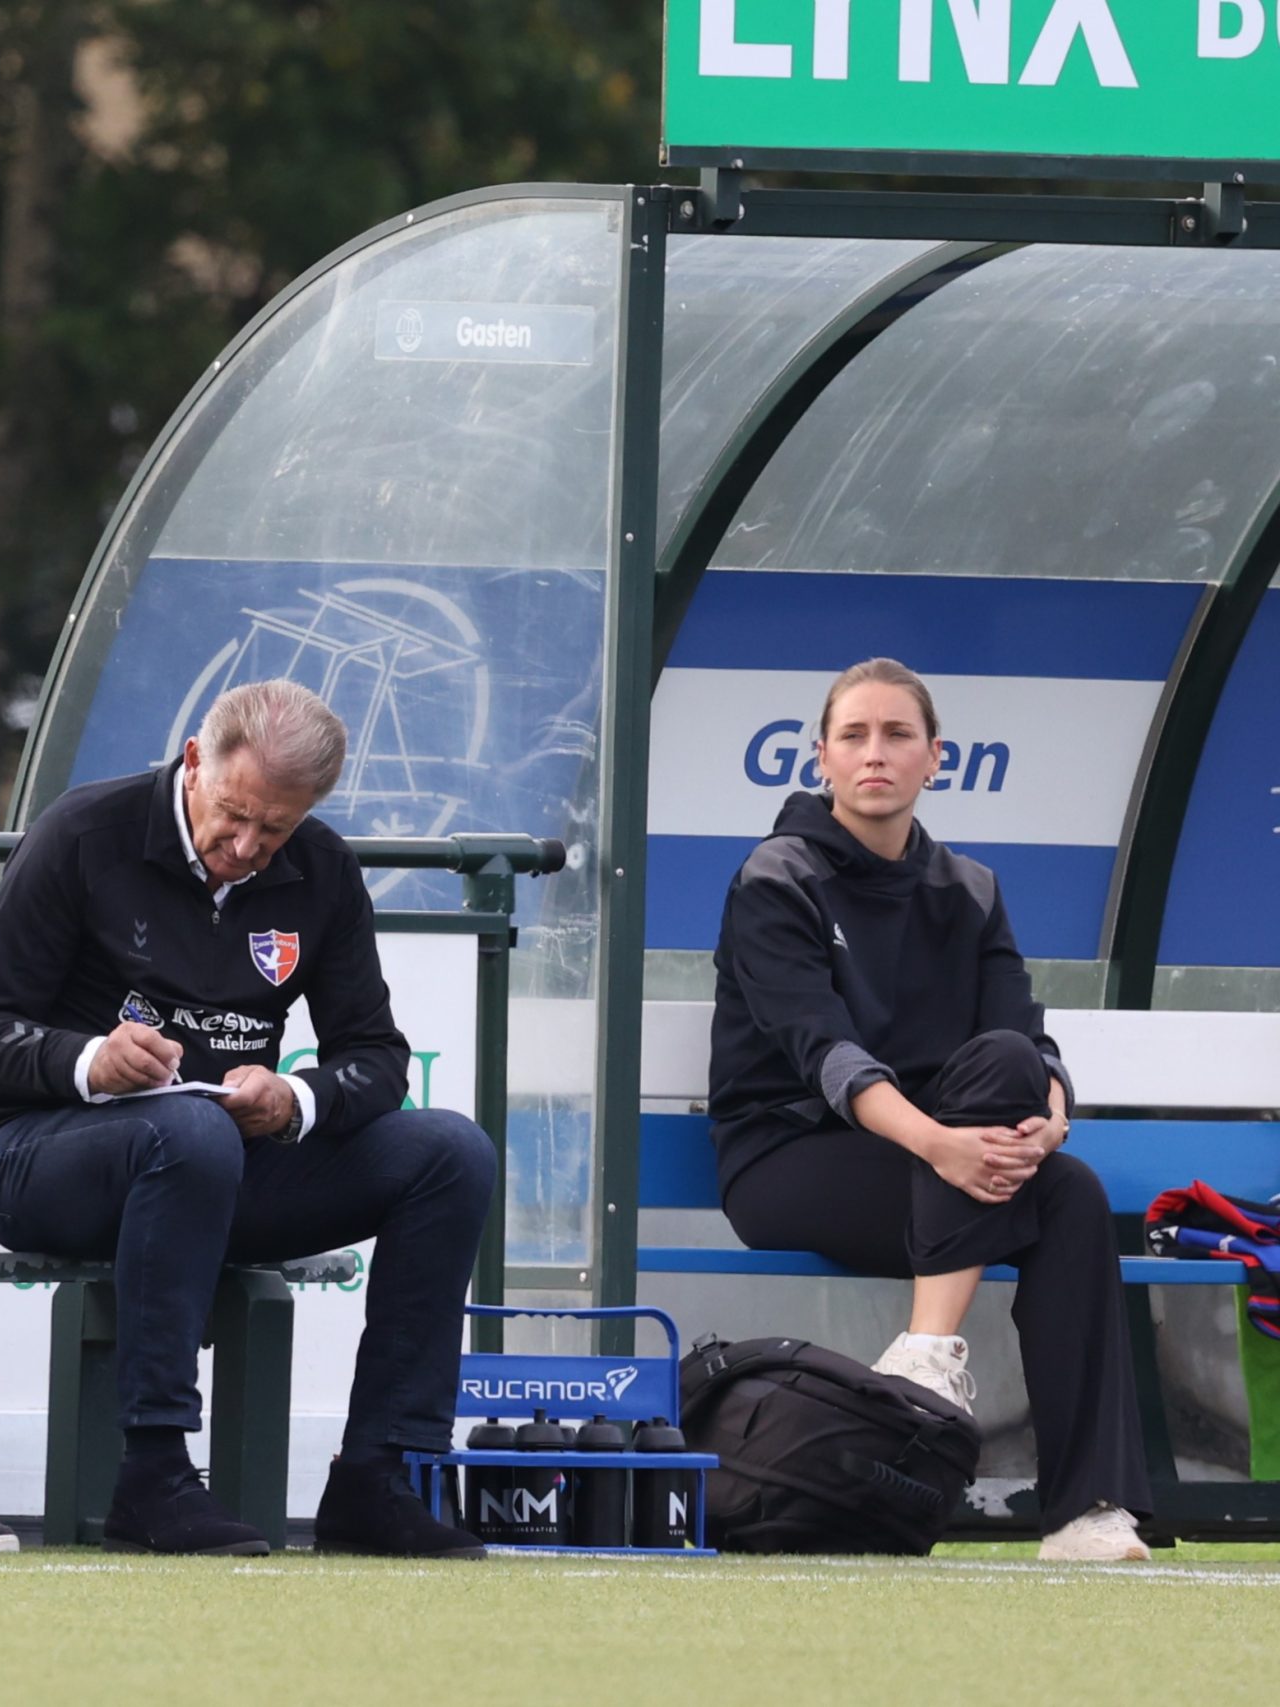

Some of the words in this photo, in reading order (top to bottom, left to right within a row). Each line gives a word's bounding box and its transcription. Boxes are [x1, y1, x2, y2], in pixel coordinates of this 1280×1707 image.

[455, 316, 532, 348] Gasten
[743, 719, 1010, 792] Gaen
[209, 1033, 270, 1051] tafelzuur
[462, 1379, 606, 1401] RUCANOR
